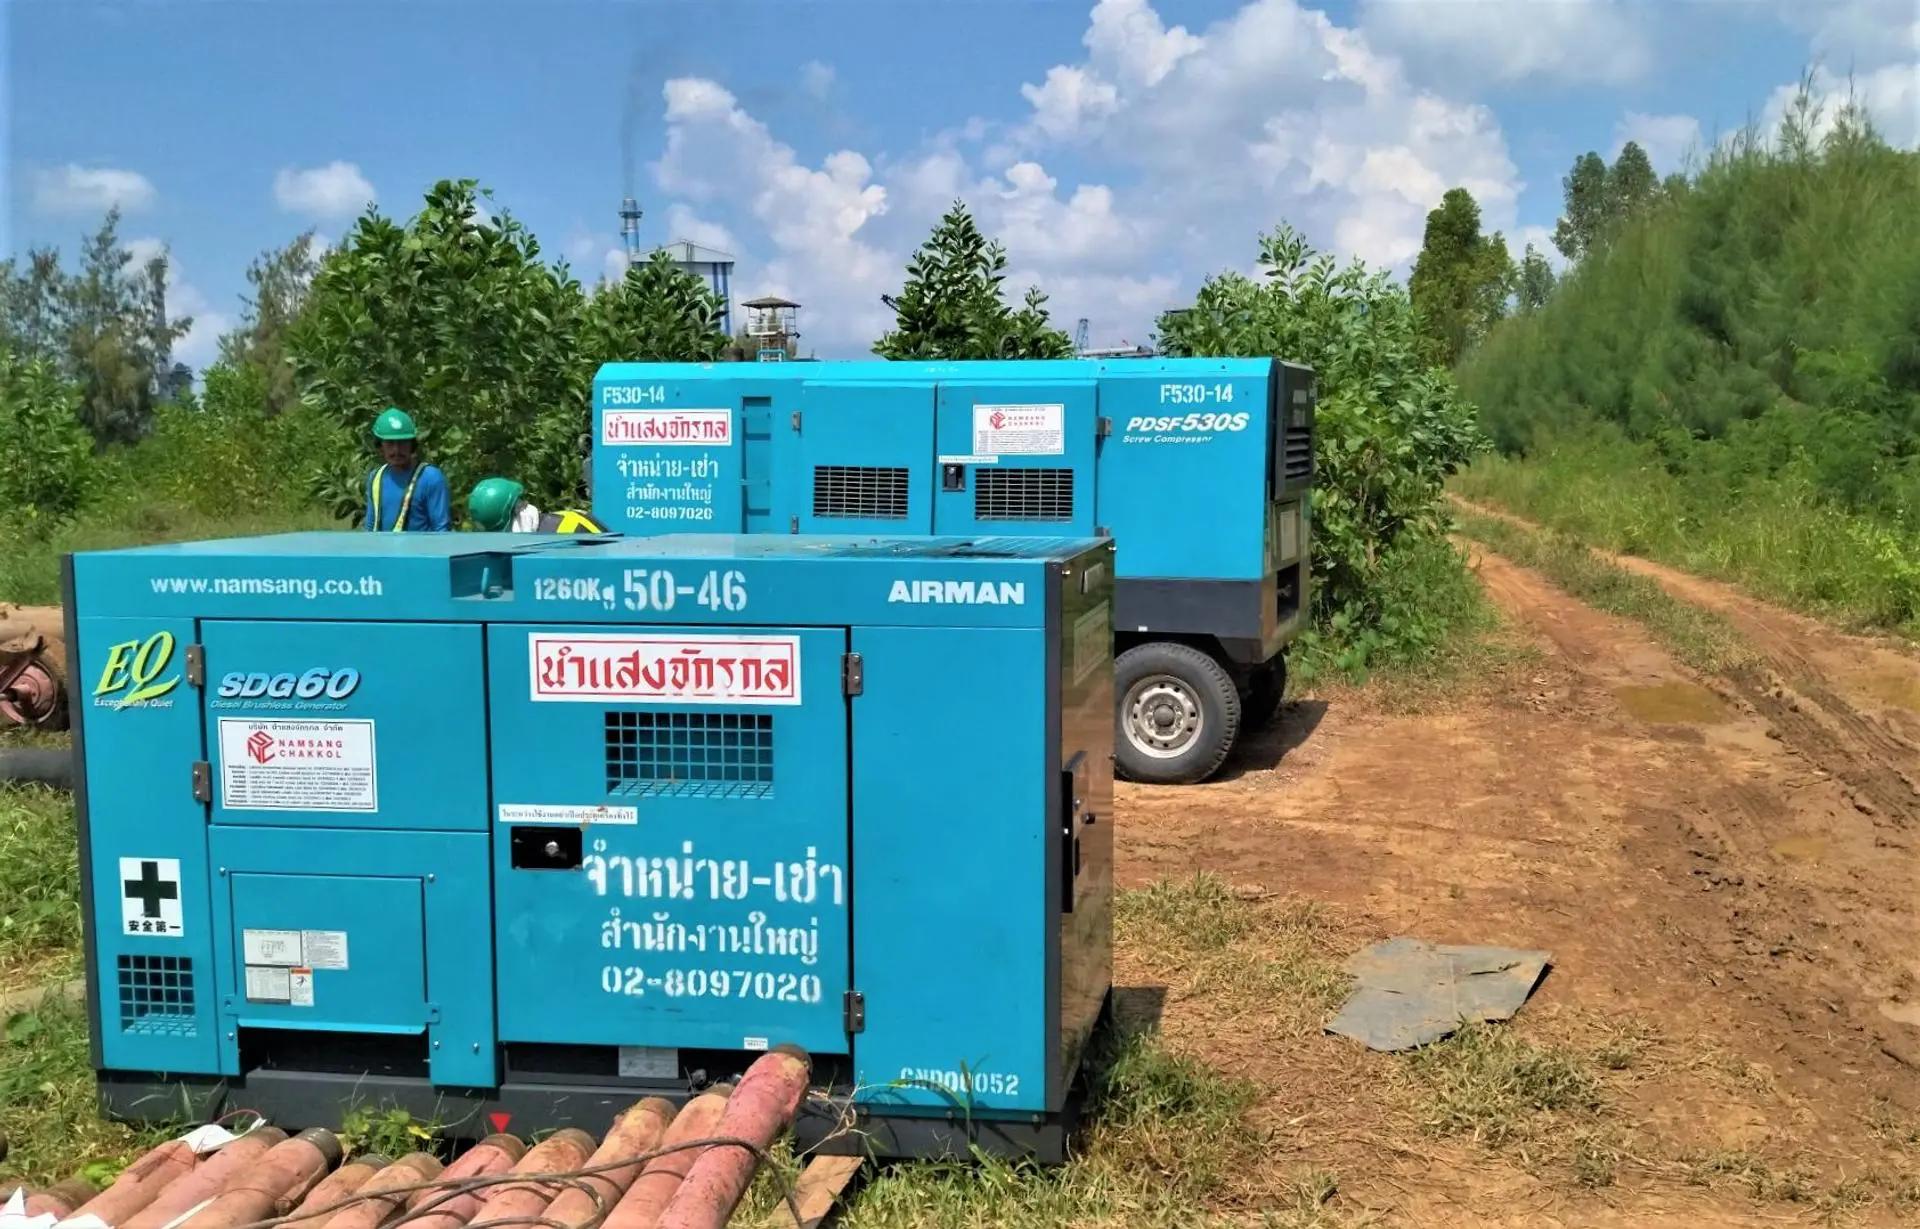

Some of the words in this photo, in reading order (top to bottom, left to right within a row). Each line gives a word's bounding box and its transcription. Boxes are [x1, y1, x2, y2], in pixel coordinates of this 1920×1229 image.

[603, 386, 665, 405] F530-14
[1160, 383, 1234, 404] F530-14
[608, 416, 727, 440] นำแสงจักรกล
[1126, 412, 1250, 432] PDSF530S
[1122, 434, 1152, 445] Screw
[1154, 434, 1212, 445] Compressor
[150, 575, 383, 600] www.namsang.co.th
[534, 577, 616, 610] 1260Kg
[623, 568, 748, 611] 50-46
[887, 580, 1025, 605] AIRMAN
[91, 631, 180, 711] EQ
[542, 646, 790, 690] นำแสงจักรกล
[218, 667, 360, 700] SDG60
[150, 698, 174, 708] Quiet
[210, 699, 241, 709] Diesel
[242, 701, 292, 711] Brushless
[295, 703, 348, 711] Generator
[278, 739, 343, 748] NAMSANG
[279, 750, 342, 758] CHAKKOL
[581, 838, 844, 906] จำหน่าย-เช่า
[128, 920, 181, 933] 安全第一
[601, 906, 819, 966] สำนักงานใหญ่
[601, 966, 822, 1003] 02-8097020
